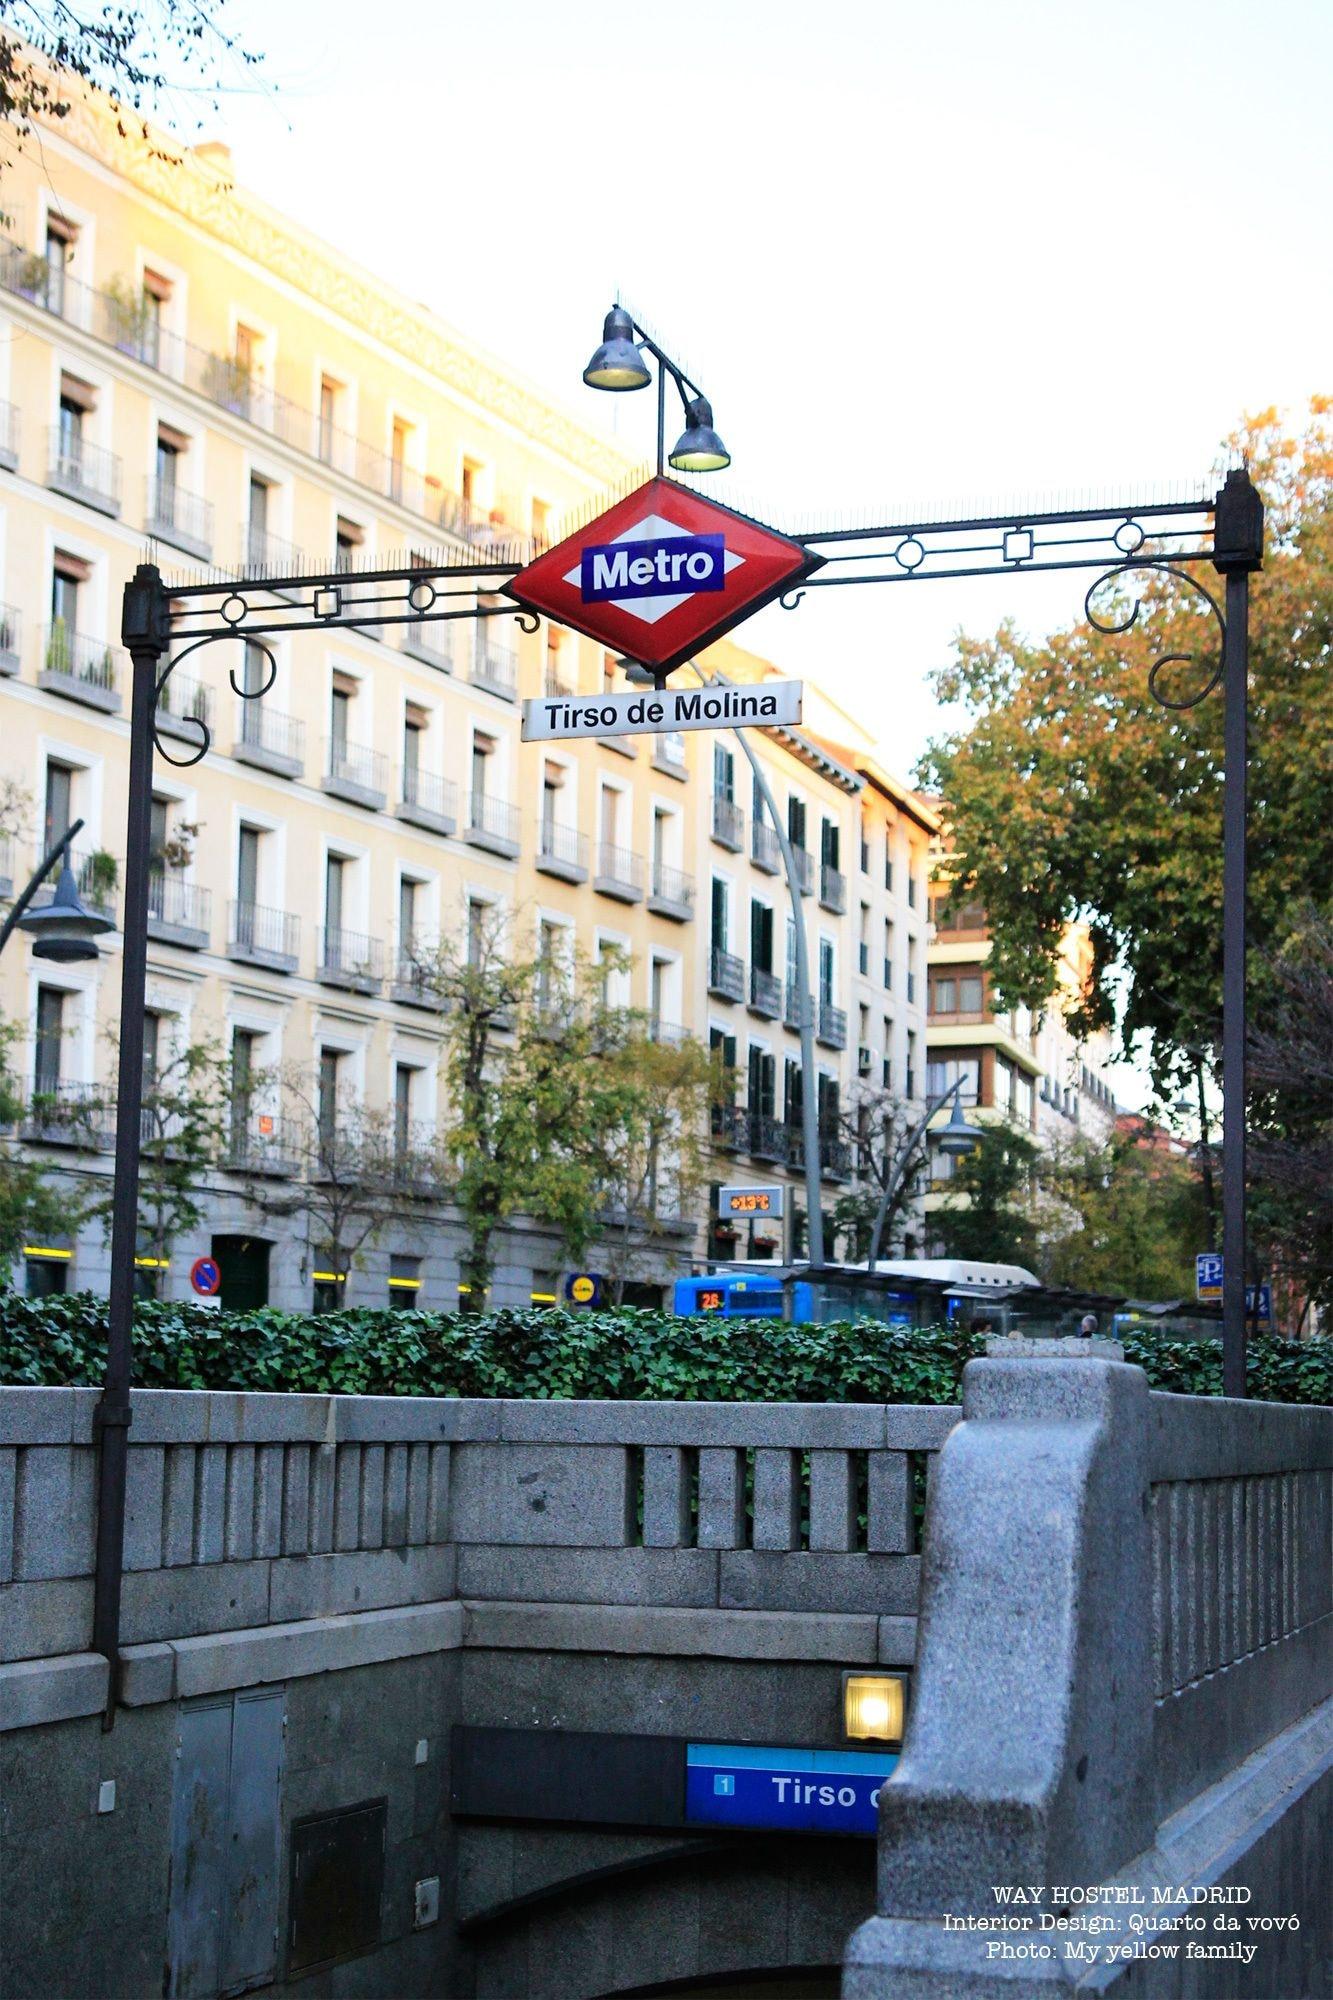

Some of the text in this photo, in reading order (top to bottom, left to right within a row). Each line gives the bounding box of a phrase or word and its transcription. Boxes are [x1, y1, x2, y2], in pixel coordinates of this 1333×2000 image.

[592, 549, 714, 590] Metro
[545, 692, 777, 730] Tirso de Molina
[721, 1778, 728, 1793] 1
[771, 1777, 856, 1807] Tirso
